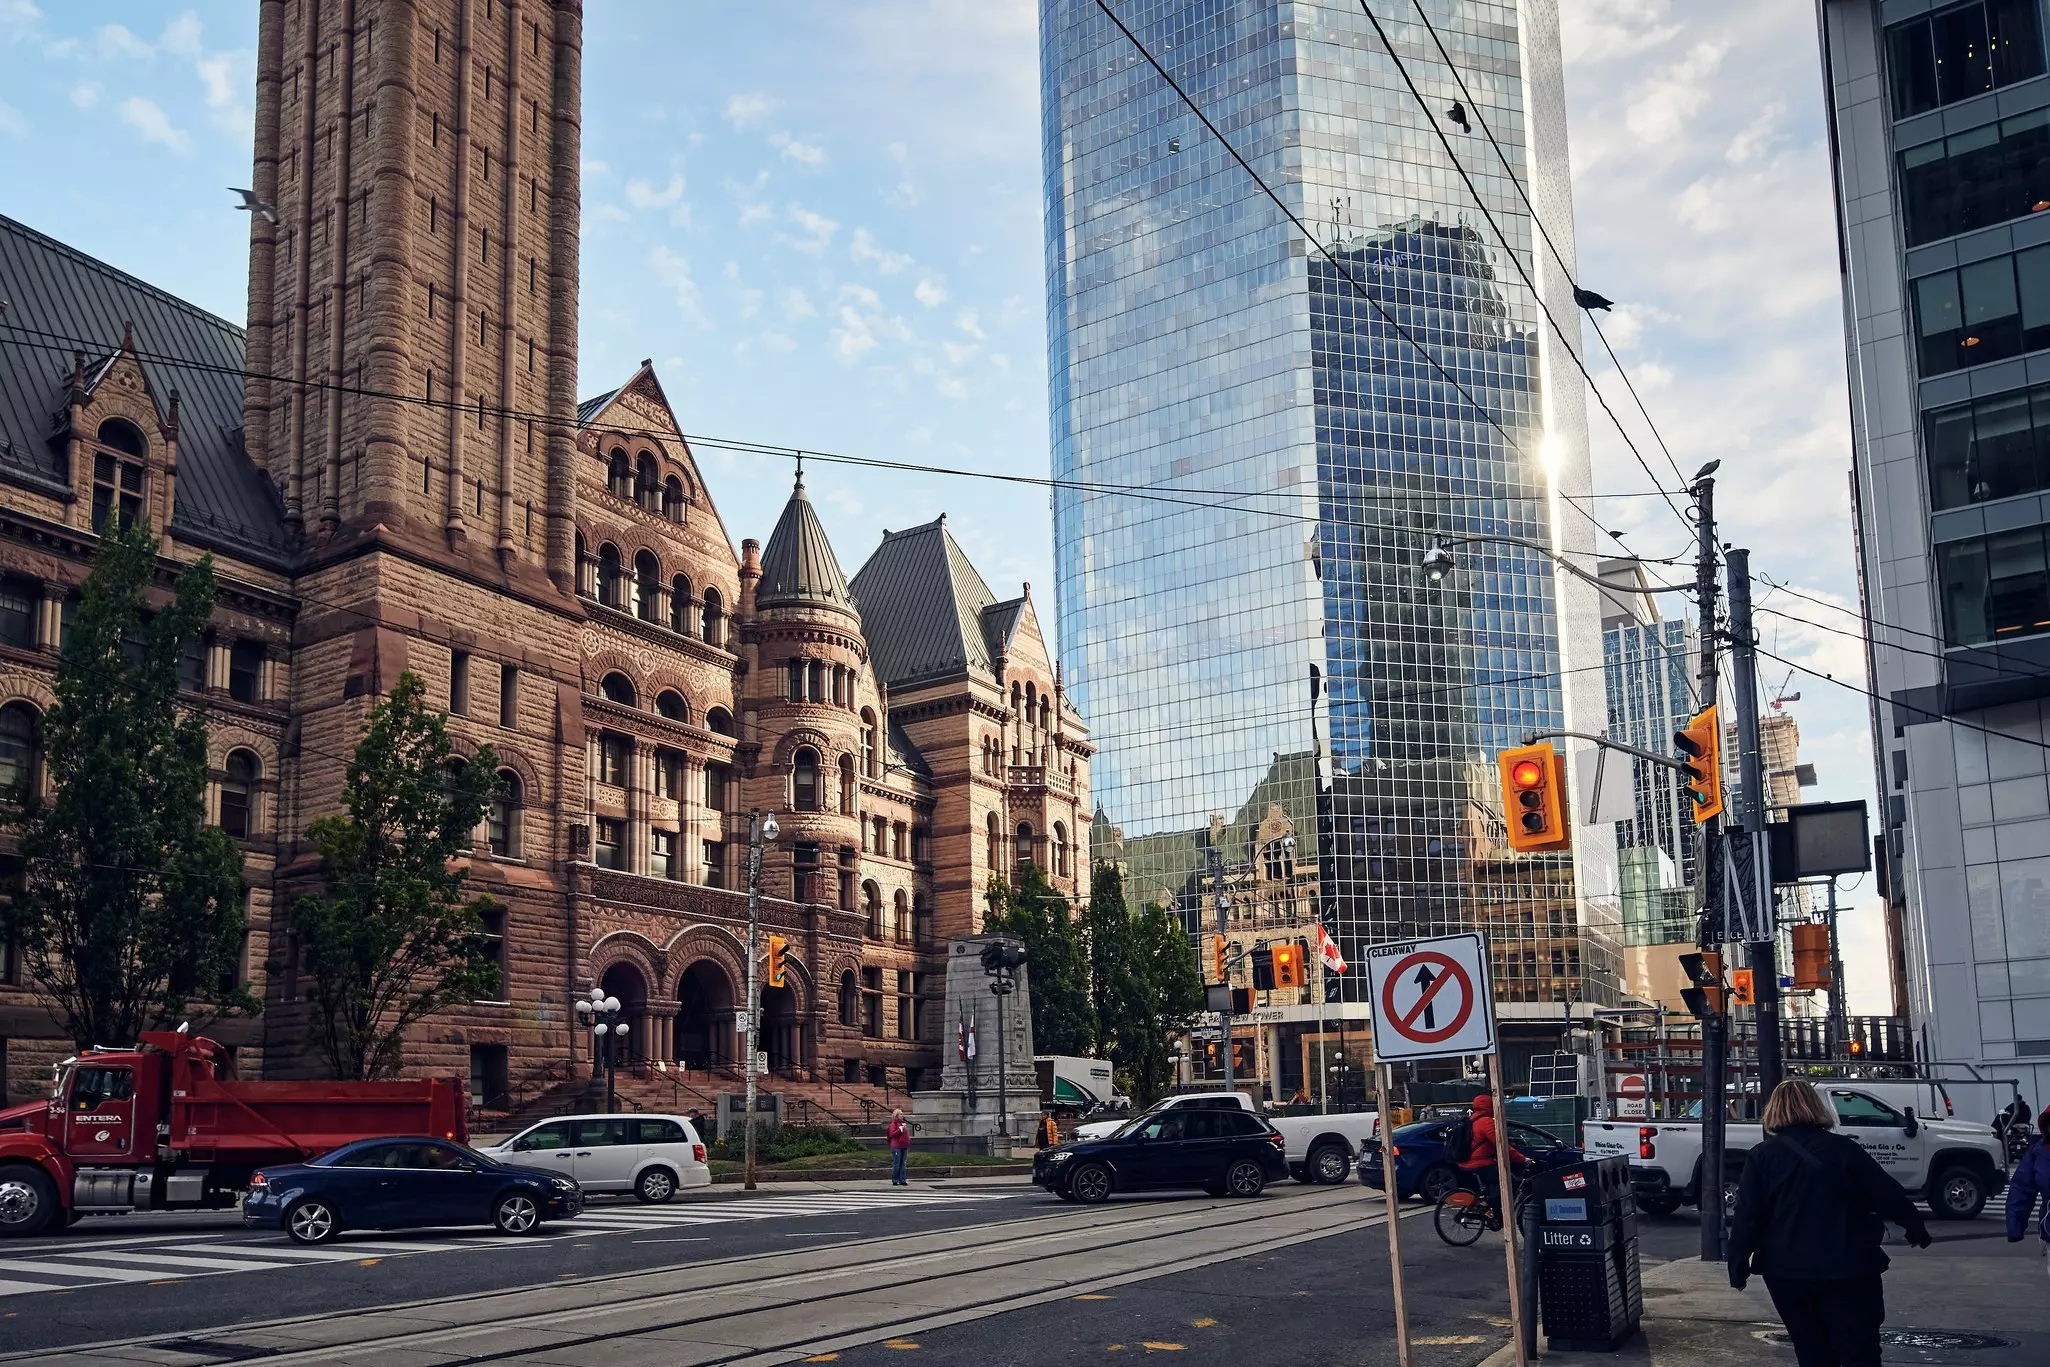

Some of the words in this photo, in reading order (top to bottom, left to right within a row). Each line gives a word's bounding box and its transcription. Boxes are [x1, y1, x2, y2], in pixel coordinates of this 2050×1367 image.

[1372, 944, 1416, 959] CLEARWAY
[1253, 1011, 1284, 1023] TOWER
[1543, 1231, 1575, 1245] Litter
